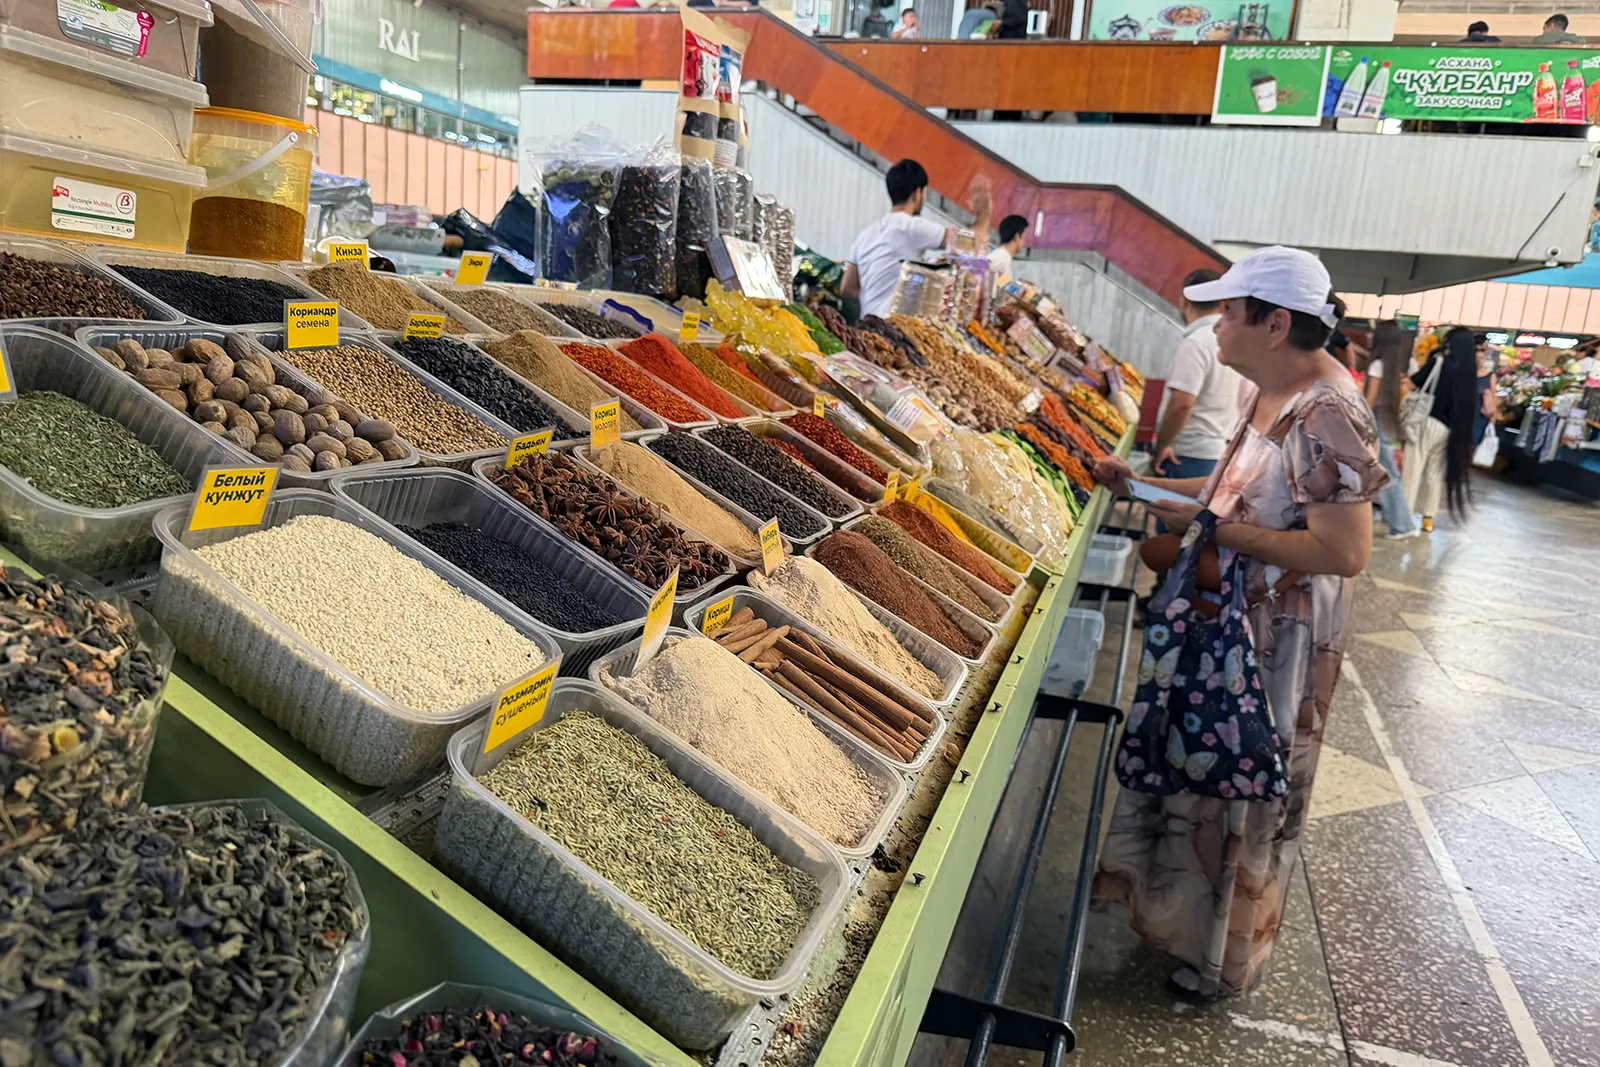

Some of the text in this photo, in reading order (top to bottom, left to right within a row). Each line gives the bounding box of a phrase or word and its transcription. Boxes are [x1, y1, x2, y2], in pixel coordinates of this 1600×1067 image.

[377, 16, 420, 61] RAI
[1437, 58, 1492, 69] АСХАНА
[1416, 96, 1502, 107] ЗАКУСОЧНАЯ
[335, 246, 363, 256] Кинза
[468, 258, 483, 268] Зира
[290, 307, 337, 318] Кориандр
[296, 319, 330, 328] семена
[410, 318, 442, 329] Барбарис
[594, 408, 617, 420] Корица
[515, 437, 546, 451] Бадьян
[213, 471, 266, 488] Белый
[205, 489, 265, 506] кунжут
[707, 603, 730, 621] Корица
[499, 673, 554, 710] Розмарин
[496, 687, 548, 727] сушеный
